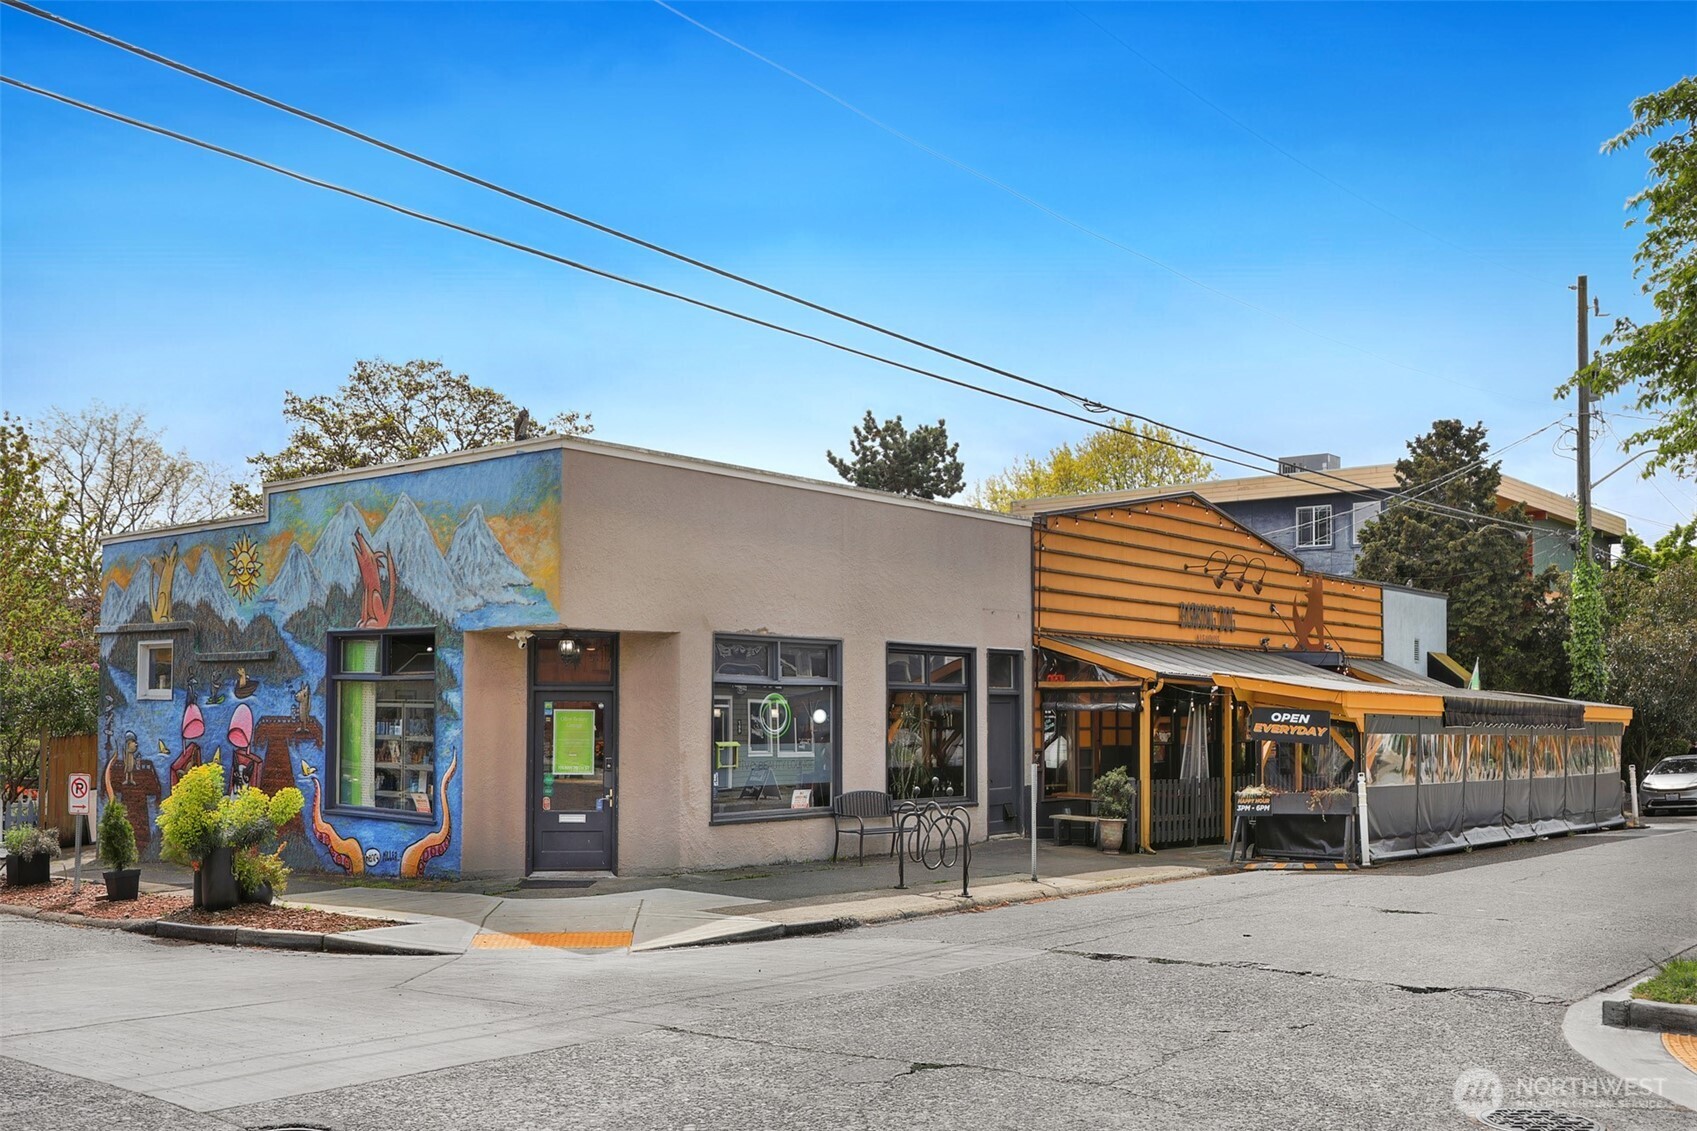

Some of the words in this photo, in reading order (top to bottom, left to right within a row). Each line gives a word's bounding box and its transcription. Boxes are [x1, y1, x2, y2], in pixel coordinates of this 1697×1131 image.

[1270, 712, 1311, 724] OPEN
[1253, 722, 1328, 737] EVERYDAY
[1236, 804, 1251, 812] 3PM
[1256, 804, 1271, 812] 6PM
